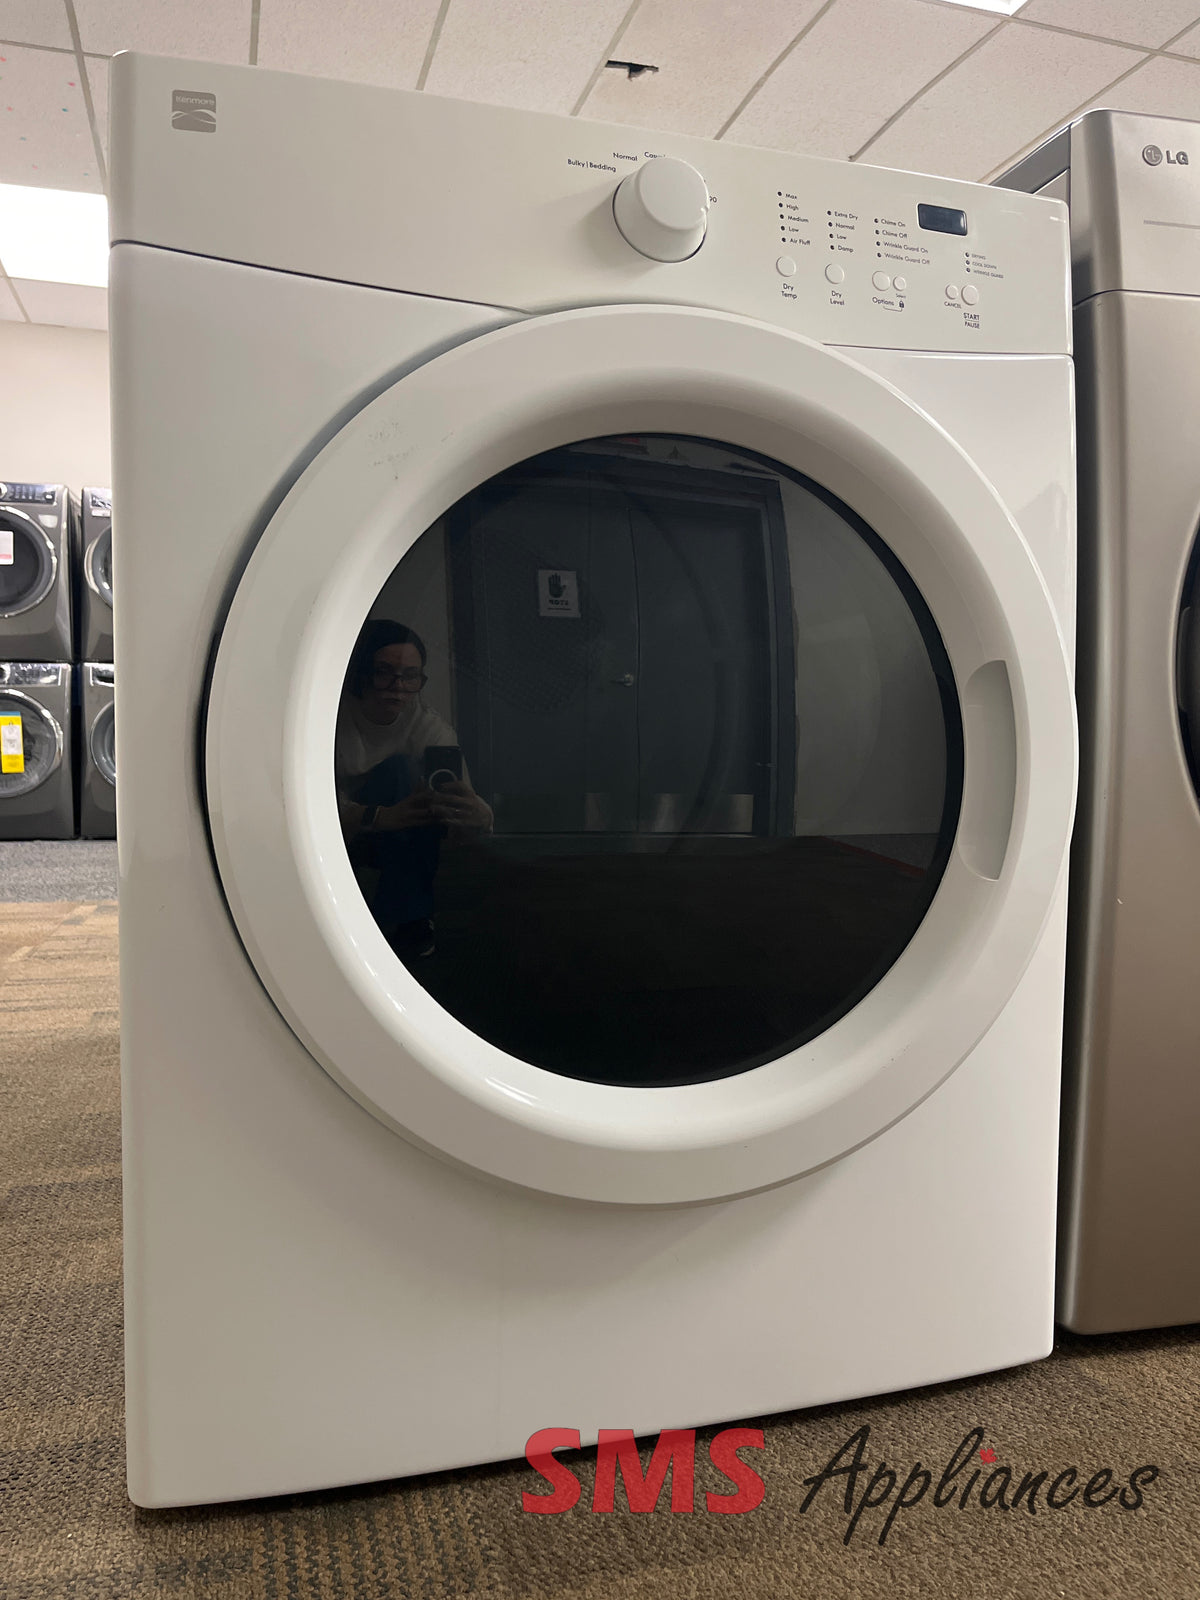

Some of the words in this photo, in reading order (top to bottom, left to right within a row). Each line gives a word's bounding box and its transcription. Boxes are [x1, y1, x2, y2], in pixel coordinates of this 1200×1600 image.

[175, 95, 215, 106] Kenmore
[612, 152, 638, 162] Normal
[1165, 150, 1189, 165] LG
[786, 203, 799, 211] High
[787, 215, 809, 223] Medium
[834, 211, 848, 219] Extra
[849, 213, 858, 221] Dry
[835, 222, 855, 231] Normal
[880, 218, 897, 227] Chime
[881, 230, 898, 238] Chime
[898, 231, 908, 239] Off
[837, 245, 854, 253] Damp
[883, 241, 903, 250] Wrinkle
[903, 244, 920, 253] Guard
[883, 252, 904, 261] Wrinkle
[904, 255, 921, 264] Guard
[782, 282, 795, 292] Dry
[781, 290, 798, 300] Temp
[831, 290, 843, 299] Dry
[829, 298, 846, 307] Level
[872, 296, 895, 306] Options
[943, 301, 962, 309] CANCEL
[963, 312, 980, 321] START
[964, 321, 980, 329] PAUSE
